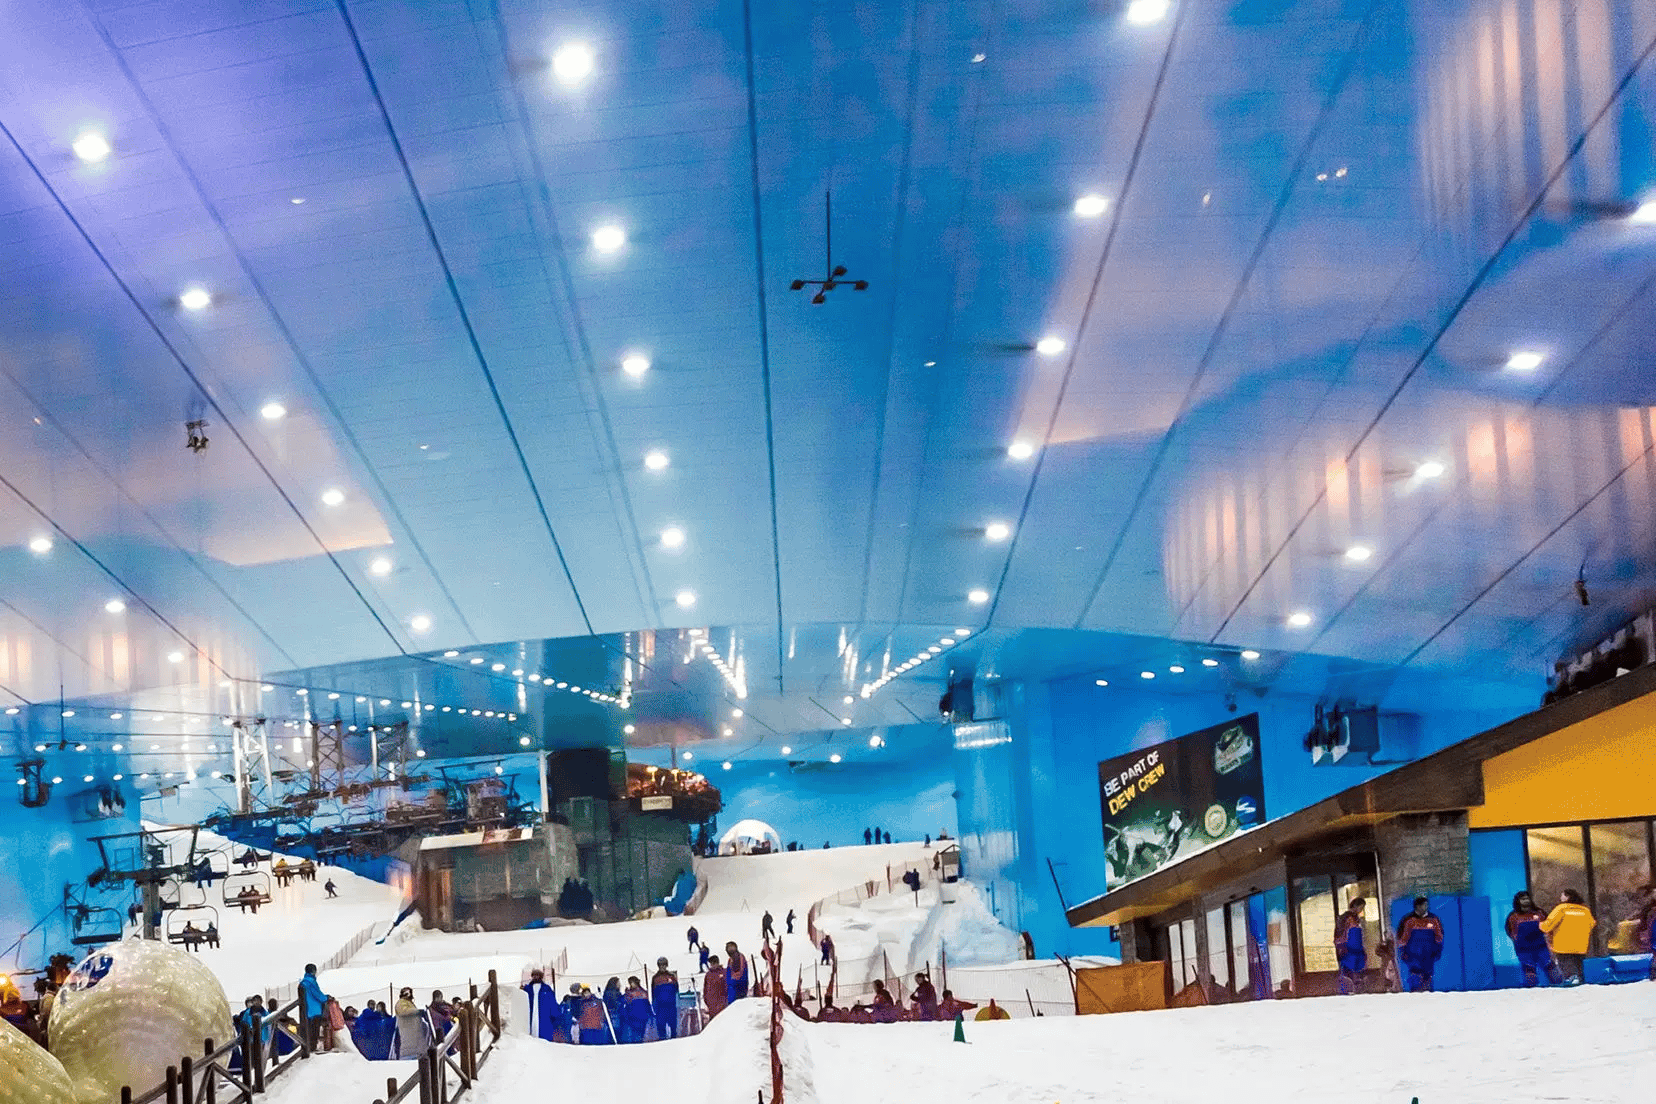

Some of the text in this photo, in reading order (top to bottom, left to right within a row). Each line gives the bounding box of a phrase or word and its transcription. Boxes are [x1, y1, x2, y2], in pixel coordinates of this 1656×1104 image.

[1104, 750, 1159, 797] BE PART OF
[1109, 763, 1165, 815] DEW CREW
